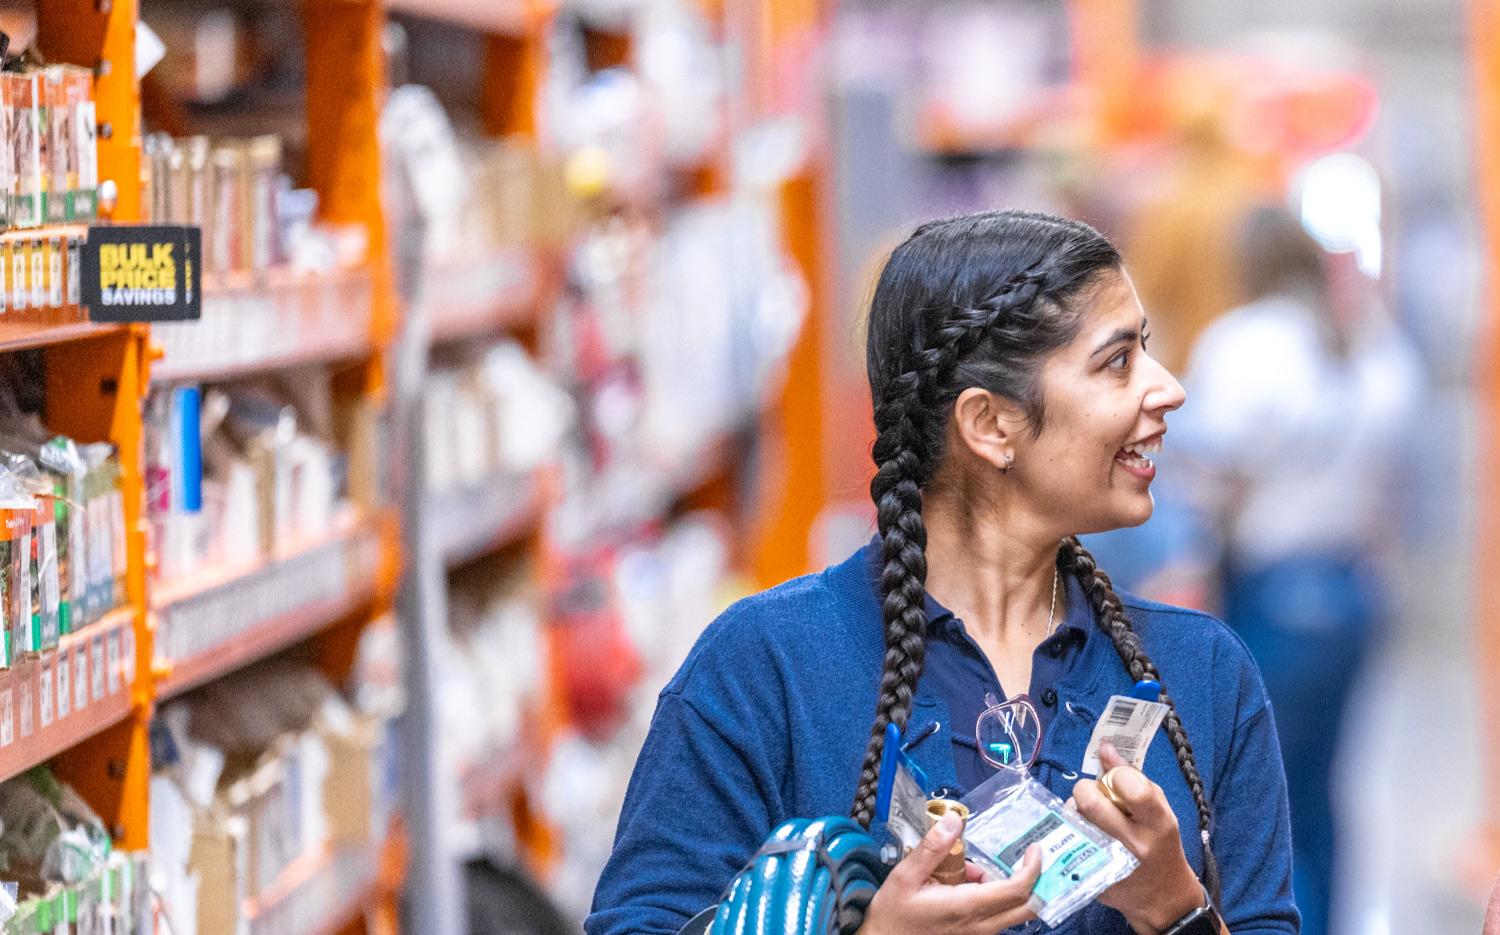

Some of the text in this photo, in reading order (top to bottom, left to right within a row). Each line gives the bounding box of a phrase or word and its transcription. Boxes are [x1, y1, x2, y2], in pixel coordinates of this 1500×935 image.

[100, 243, 175, 269] BULK
[100, 268, 176, 289] PRICE
[102, 288, 176, 306] SAVINGS
